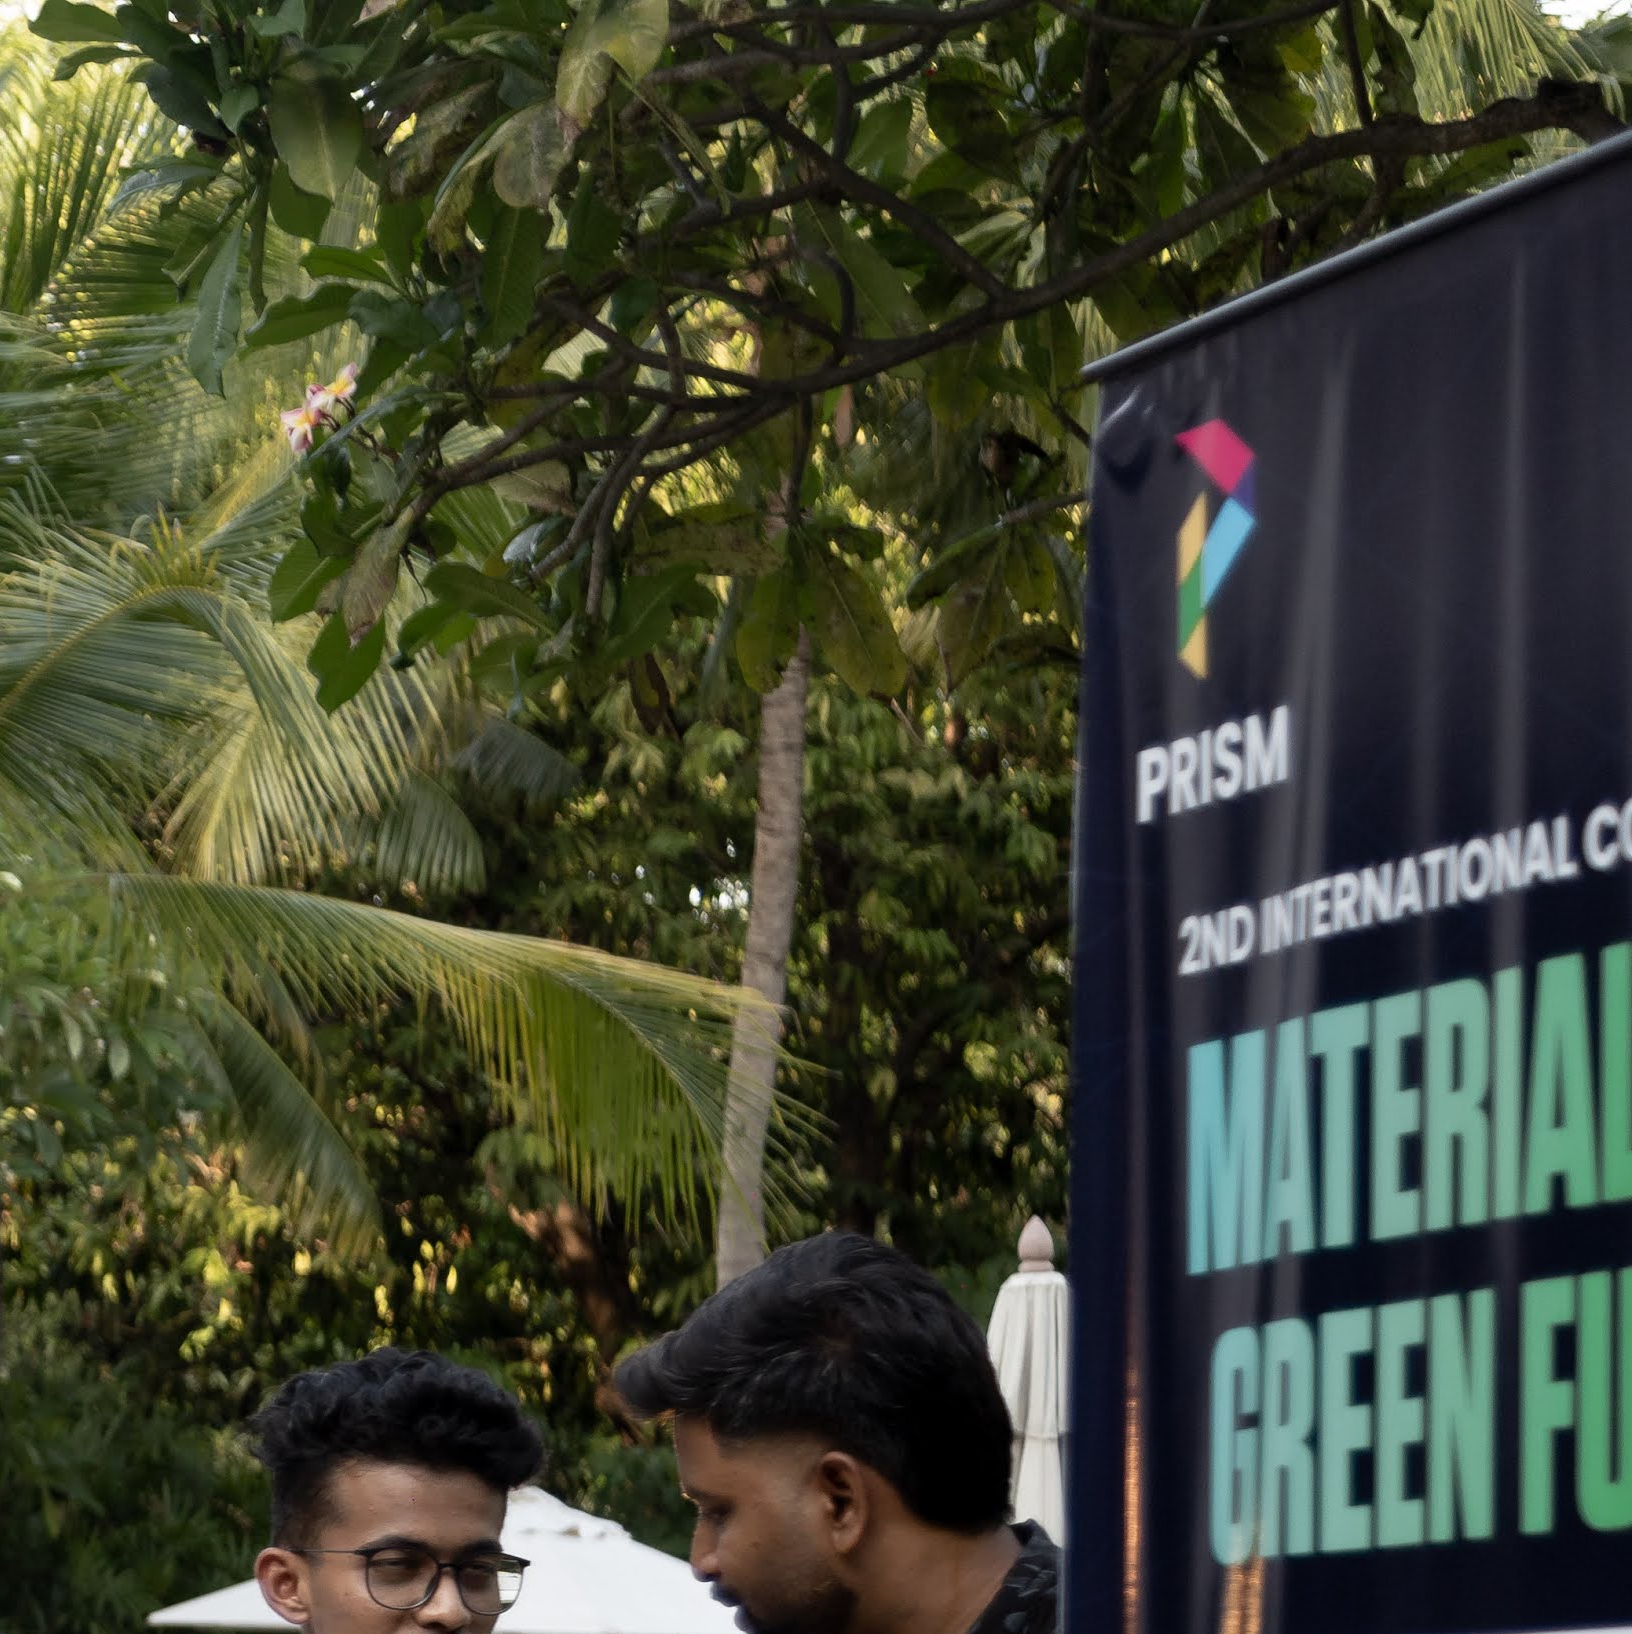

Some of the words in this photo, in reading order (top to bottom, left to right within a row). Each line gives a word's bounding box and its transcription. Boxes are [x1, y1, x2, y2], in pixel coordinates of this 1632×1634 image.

[1137, 705, 1290, 824] PRISM
[1177, 906, 1255, 976] 2ND
[1261, 812, 1580, 955] INTERNATIONAL
[1210, 1286, 1497, 1567] GREEN
[1519, 1265, 1632, 1535] FU
